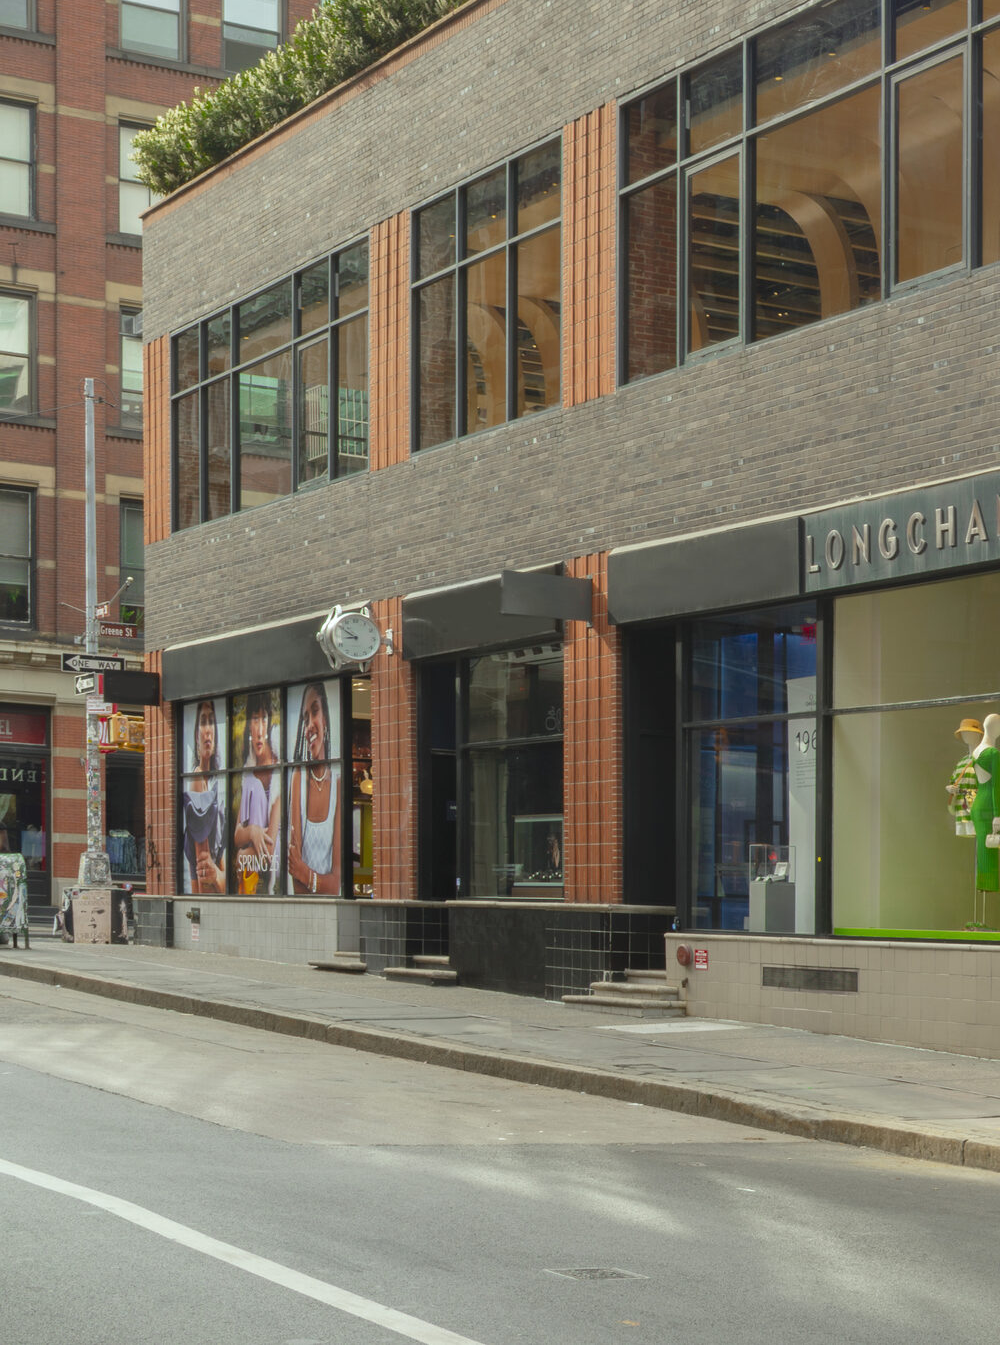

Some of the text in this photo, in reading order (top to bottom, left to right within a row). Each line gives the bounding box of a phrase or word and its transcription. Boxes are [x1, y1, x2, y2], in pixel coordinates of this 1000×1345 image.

[100, 625, 133, 637] Greene St
[72, 659, 117, 670] ONE WAY
[238, 854, 268, 872] SPRING
